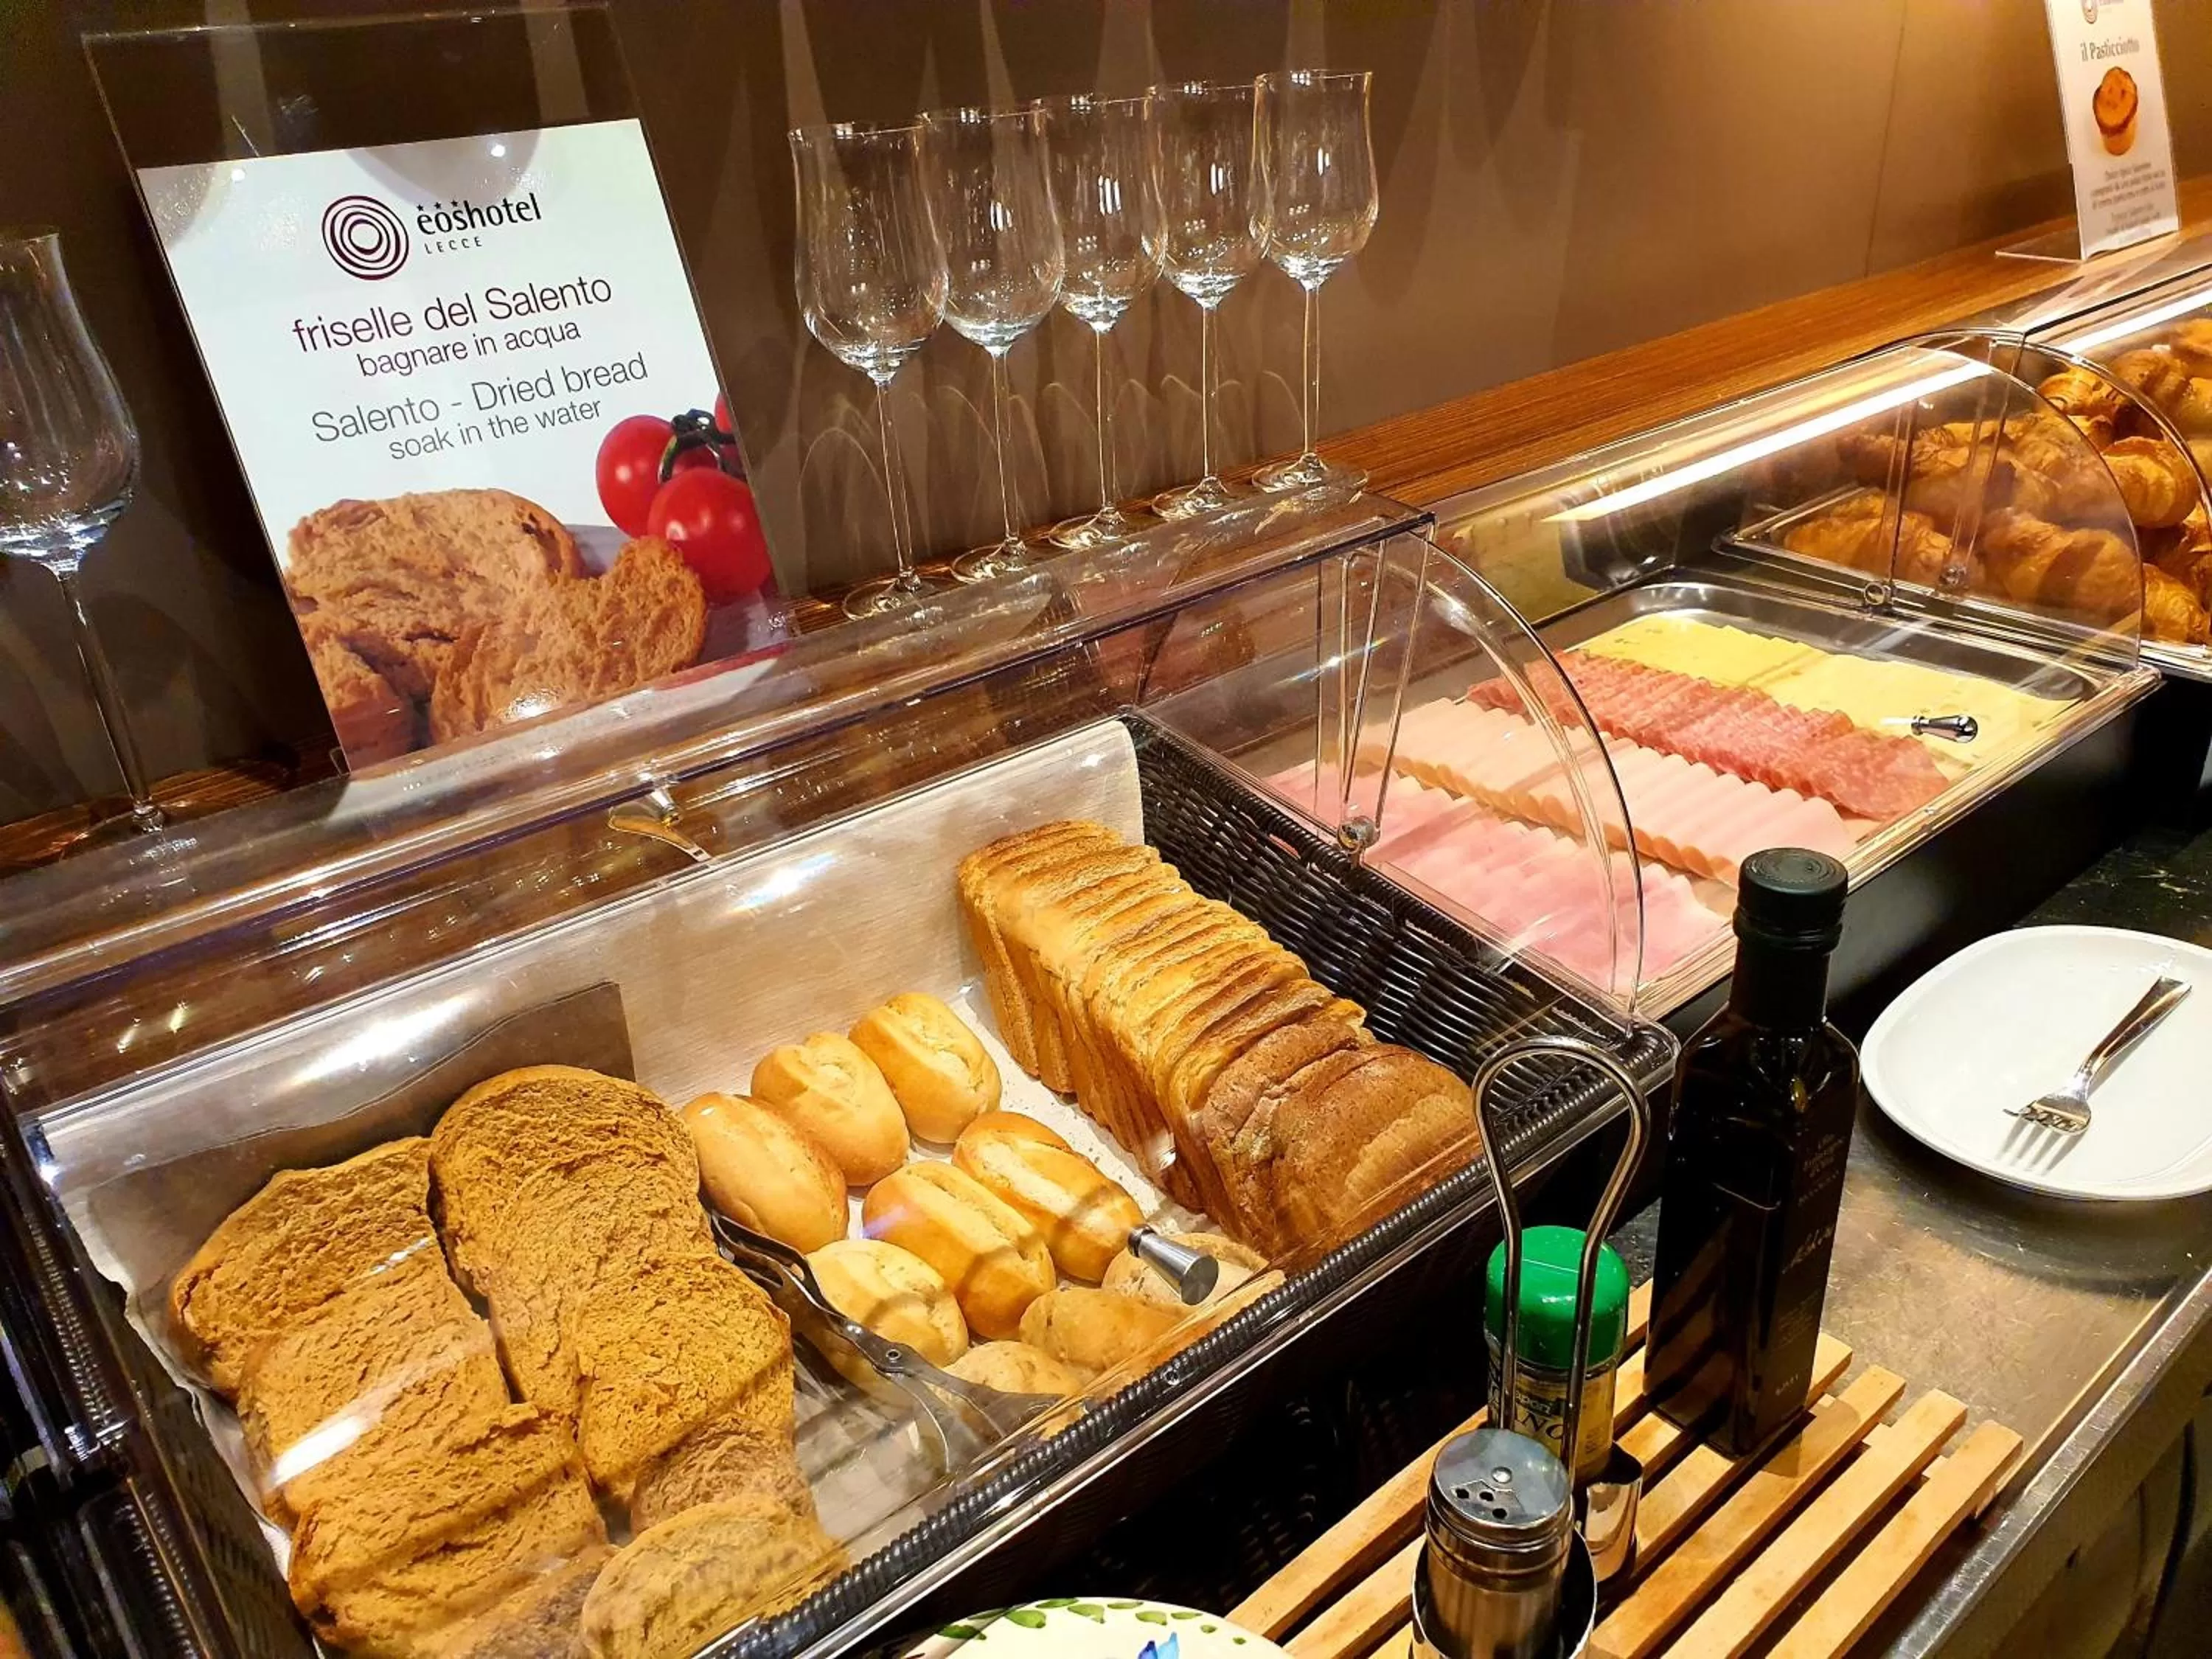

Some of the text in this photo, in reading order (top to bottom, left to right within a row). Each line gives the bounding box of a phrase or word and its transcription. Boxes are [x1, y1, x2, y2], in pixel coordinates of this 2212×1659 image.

[424, 235, 483, 254] LECCE
[292, 276, 612, 353] friselle del Salento
[356, 321, 582, 378] bagnare in acqua
[312, 397, 440, 442] Salento
[470, 369, 556, 411] Dried
[560, 351, 649, 393] bread
[389, 398, 602, 460] soak in the water
